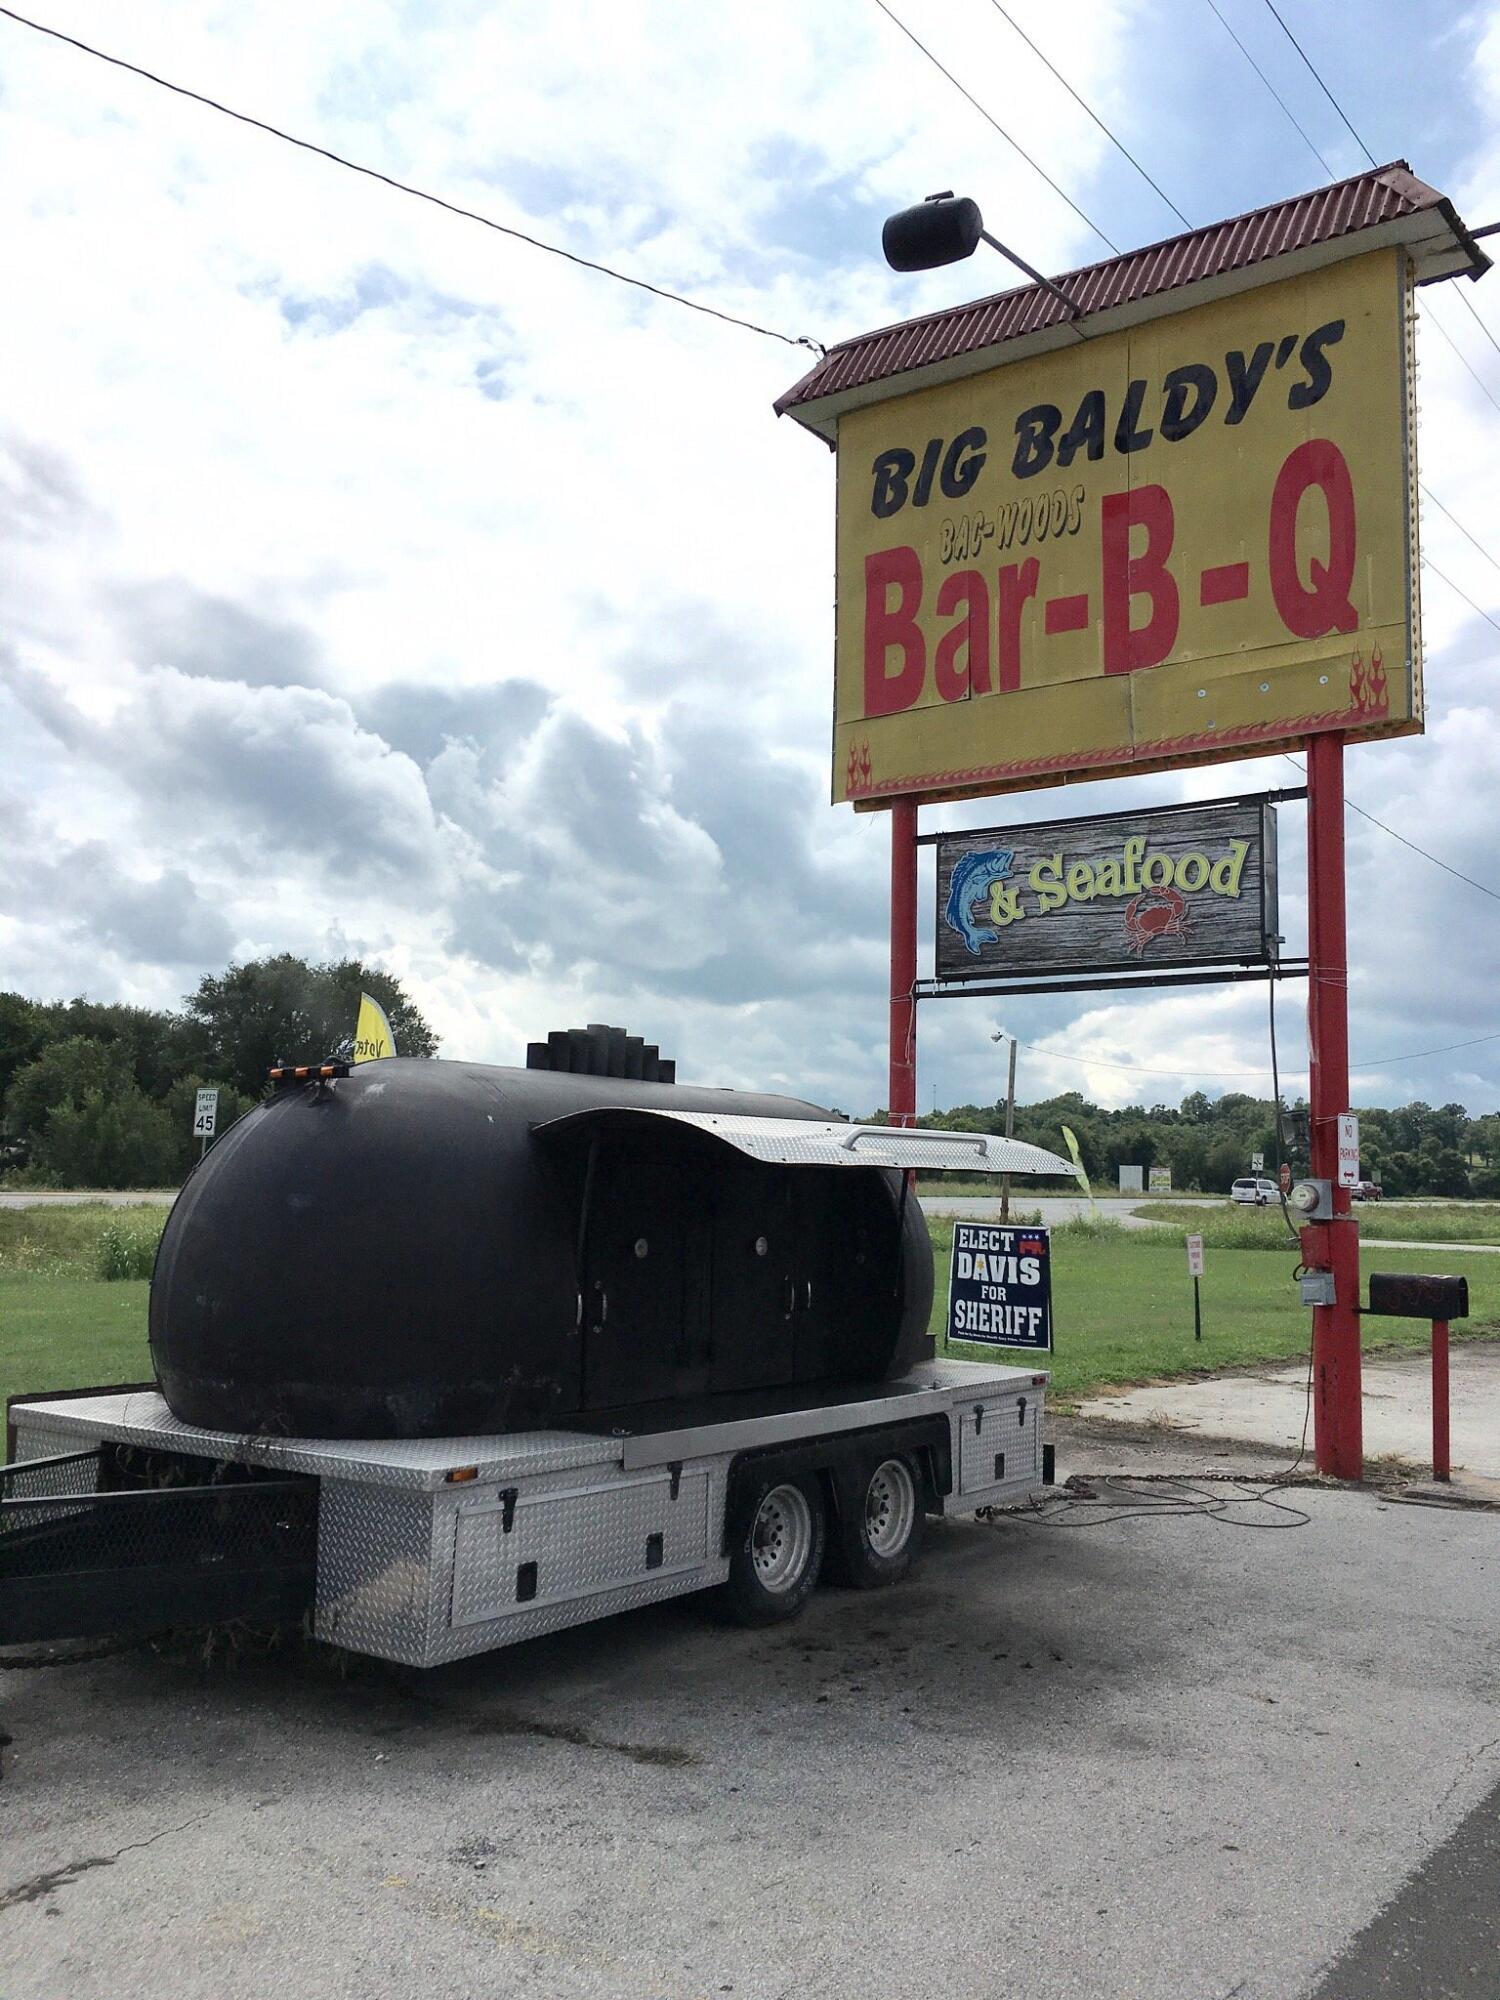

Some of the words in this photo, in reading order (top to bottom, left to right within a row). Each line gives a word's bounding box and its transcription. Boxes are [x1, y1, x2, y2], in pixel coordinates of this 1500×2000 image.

[871, 426, 988, 519] BIG
[1011, 319, 1346, 480] BALDY'S
[863, 438, 1359, 718] Bar-B-Q
[989, 880, 1026, 926] &
[1028, 835, 1251, 915] Seafood
[198, 1093, 217, 1102] SPEED
[199, 1104, 214, 1112] LIMIT
[196, 1115, 214, 1131] 45
[1345, 1124, 1353, 1138] NO
[958, 1228, 1015, 1252] ELECT
[957, 1251, 1041, 1286] DAVIS
[981, 1285, 1007, 1301] FOR
[954, 1299, 1042, 1337] SHERIFF
